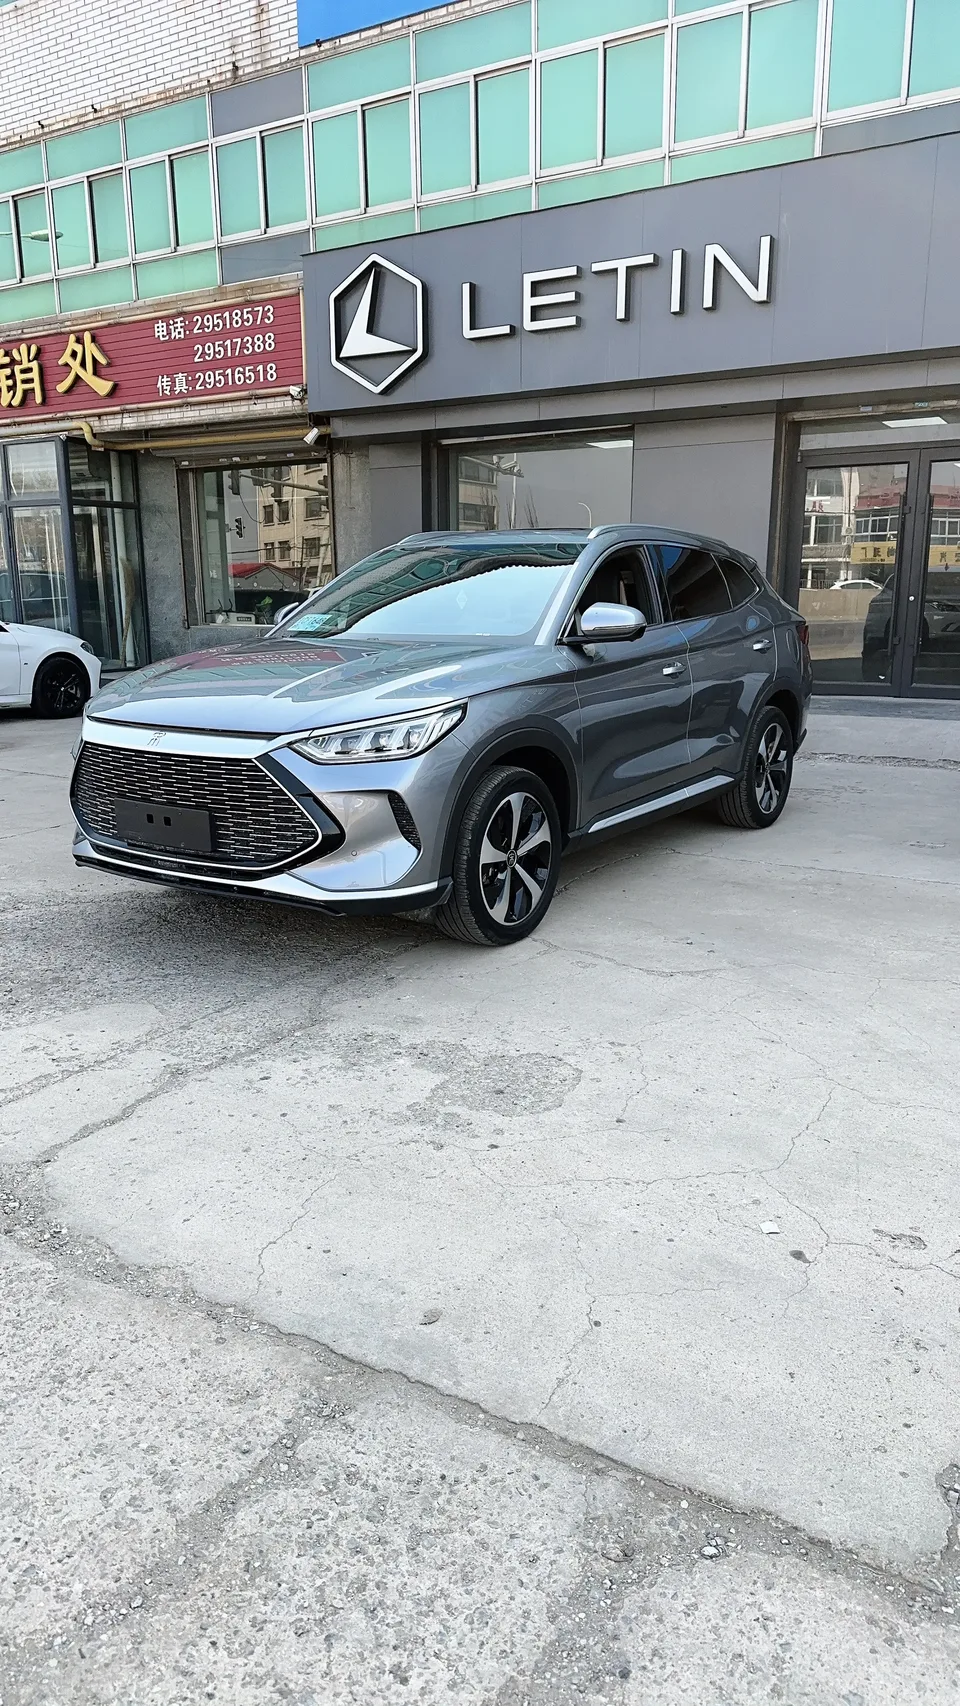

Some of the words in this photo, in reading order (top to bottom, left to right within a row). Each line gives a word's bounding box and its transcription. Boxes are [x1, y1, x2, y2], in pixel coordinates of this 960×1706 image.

[461, 234, 775, 340] LETIN
[154, 304, 275, 342] 电话:29518573
[193, 332, 276, 363] 29517388
[156, 363, 278, 397] 传真:29516518
